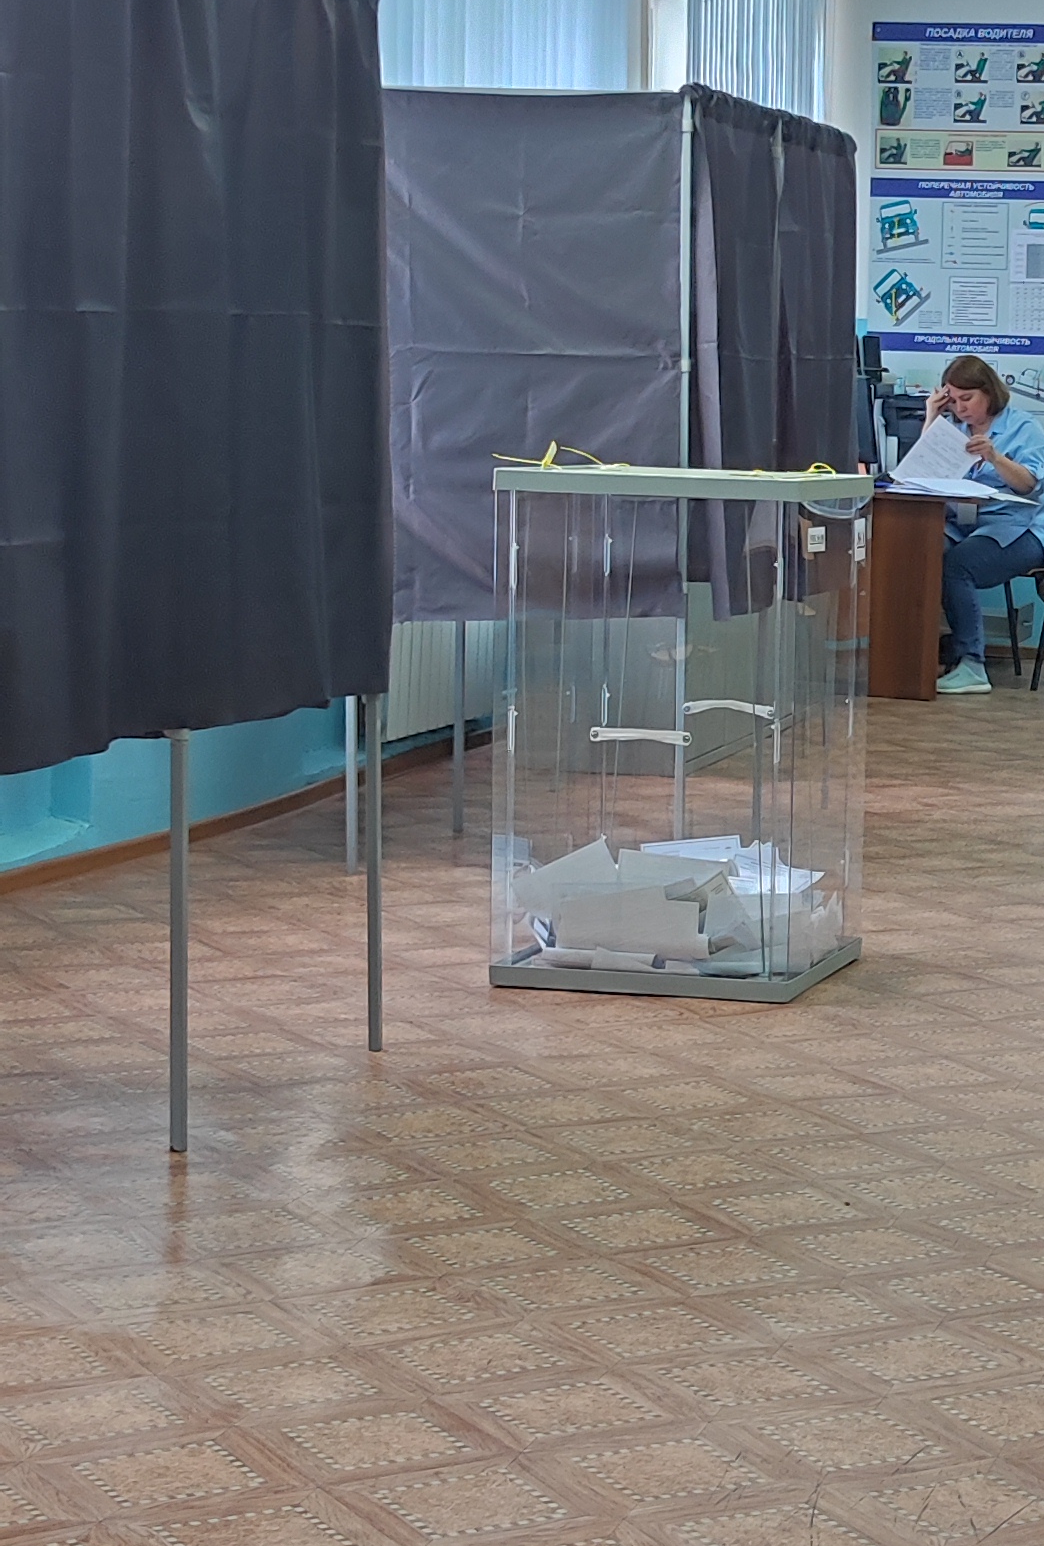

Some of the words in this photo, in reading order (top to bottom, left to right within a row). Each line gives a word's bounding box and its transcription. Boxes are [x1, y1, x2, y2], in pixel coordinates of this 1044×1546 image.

[926, 28, 975, 39] ПОСАДКА
[977, 29, 1034, 40] ВОДИТЕЛЯ
[918, 181, 971, 189] ПОПЕРЕЧНАЯ
[973, 181, 1035, 191] УСТОЙЧИВОСТЬ
[913, 335, 968, 344] ПРОДОЛЬНАЯ
[969, 336, 1031, 346] УСТОЙЧИВОСТЬ
[945, 345, 1000, 353] АВТОМОБИЛЯ
